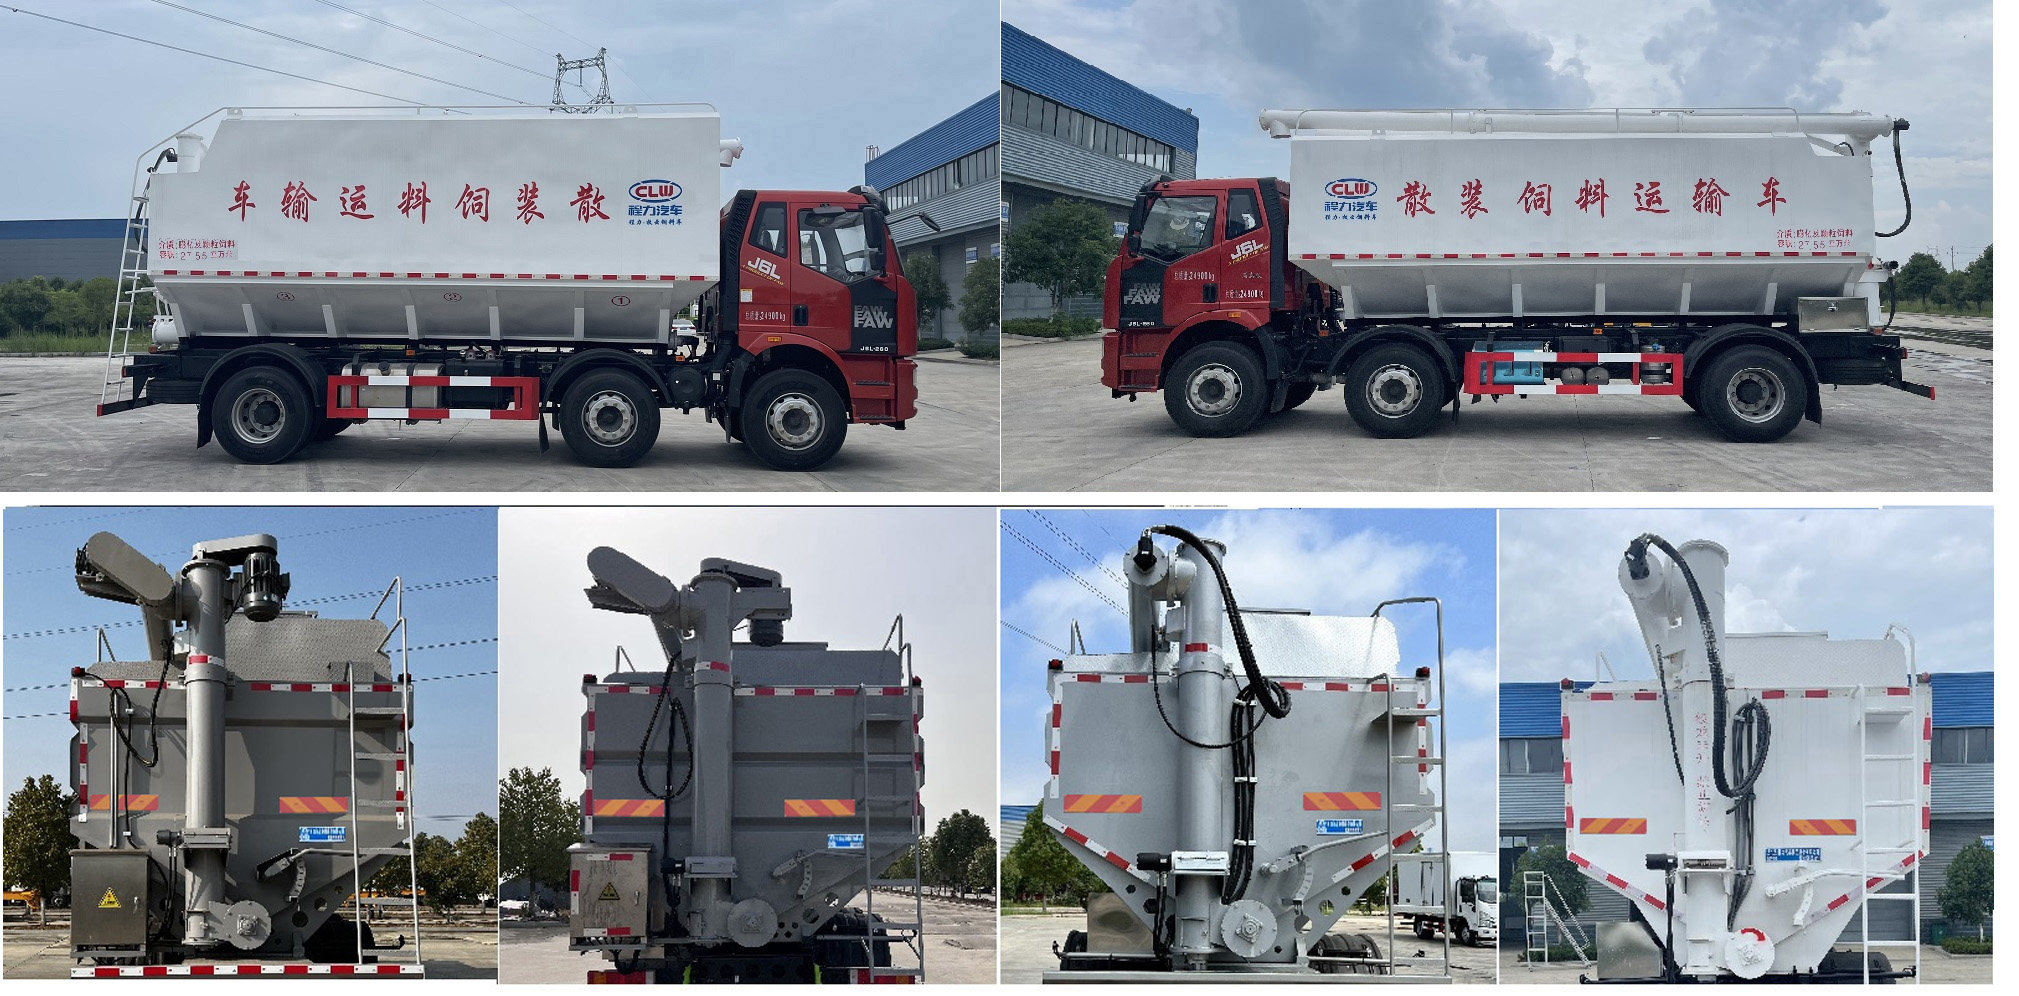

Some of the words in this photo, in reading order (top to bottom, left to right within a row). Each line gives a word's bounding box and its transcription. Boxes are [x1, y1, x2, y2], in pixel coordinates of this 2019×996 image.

[634, 185, 674, 198] CLW
[1331, 182, 1370, 196] CLW
[628, 204, 683, 216] 程力汽车
[1324, 200, 1378, 212] 程力汽车
[747, 257, 781, 280] J6L
